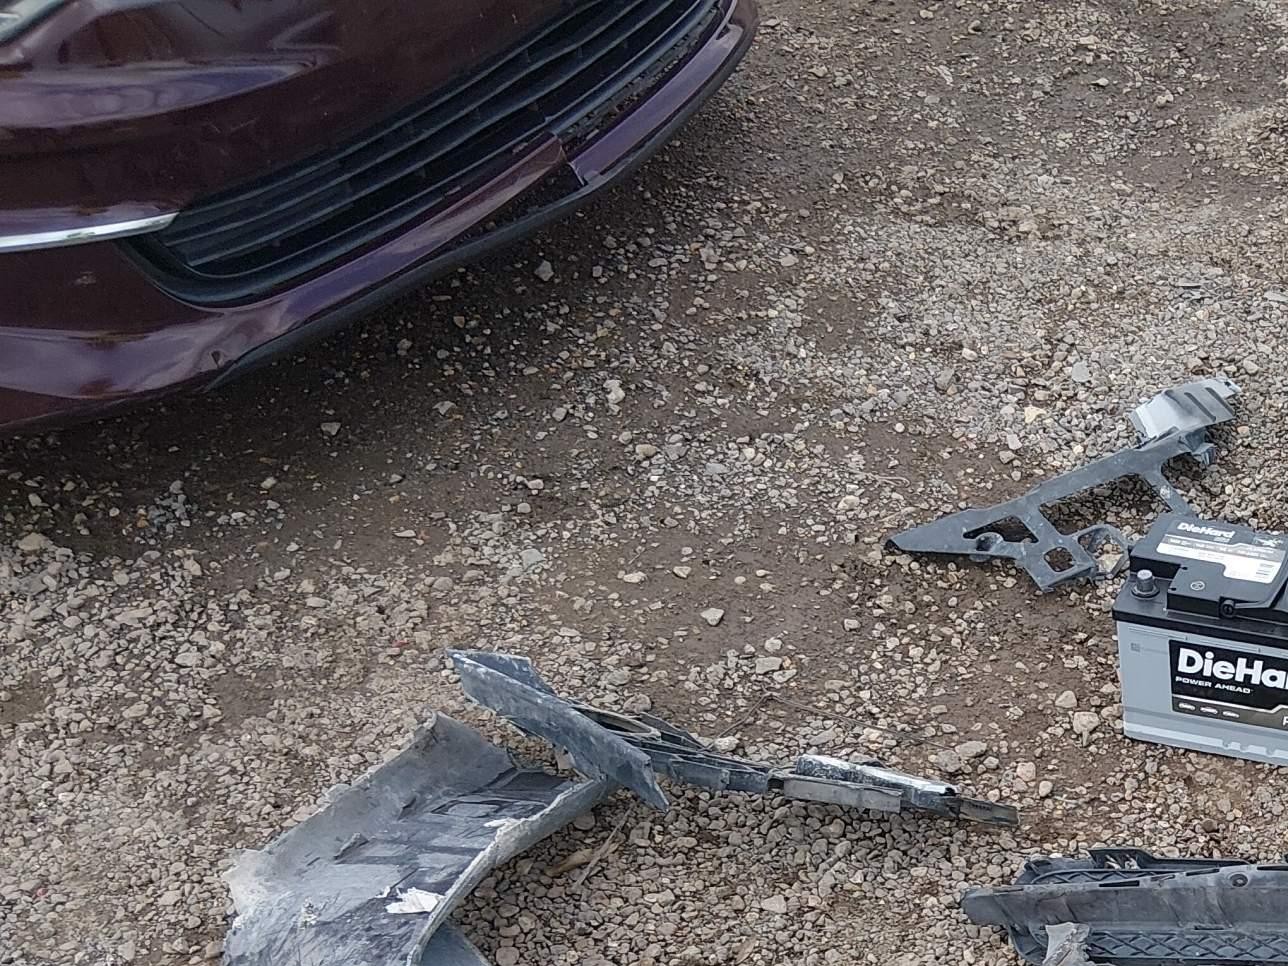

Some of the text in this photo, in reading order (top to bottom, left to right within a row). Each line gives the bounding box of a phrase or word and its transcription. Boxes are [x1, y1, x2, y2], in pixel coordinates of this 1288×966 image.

[1176, 522, 1236, 538] DieHard
[1175, 676, 1251, 694] POWER AHEAD
